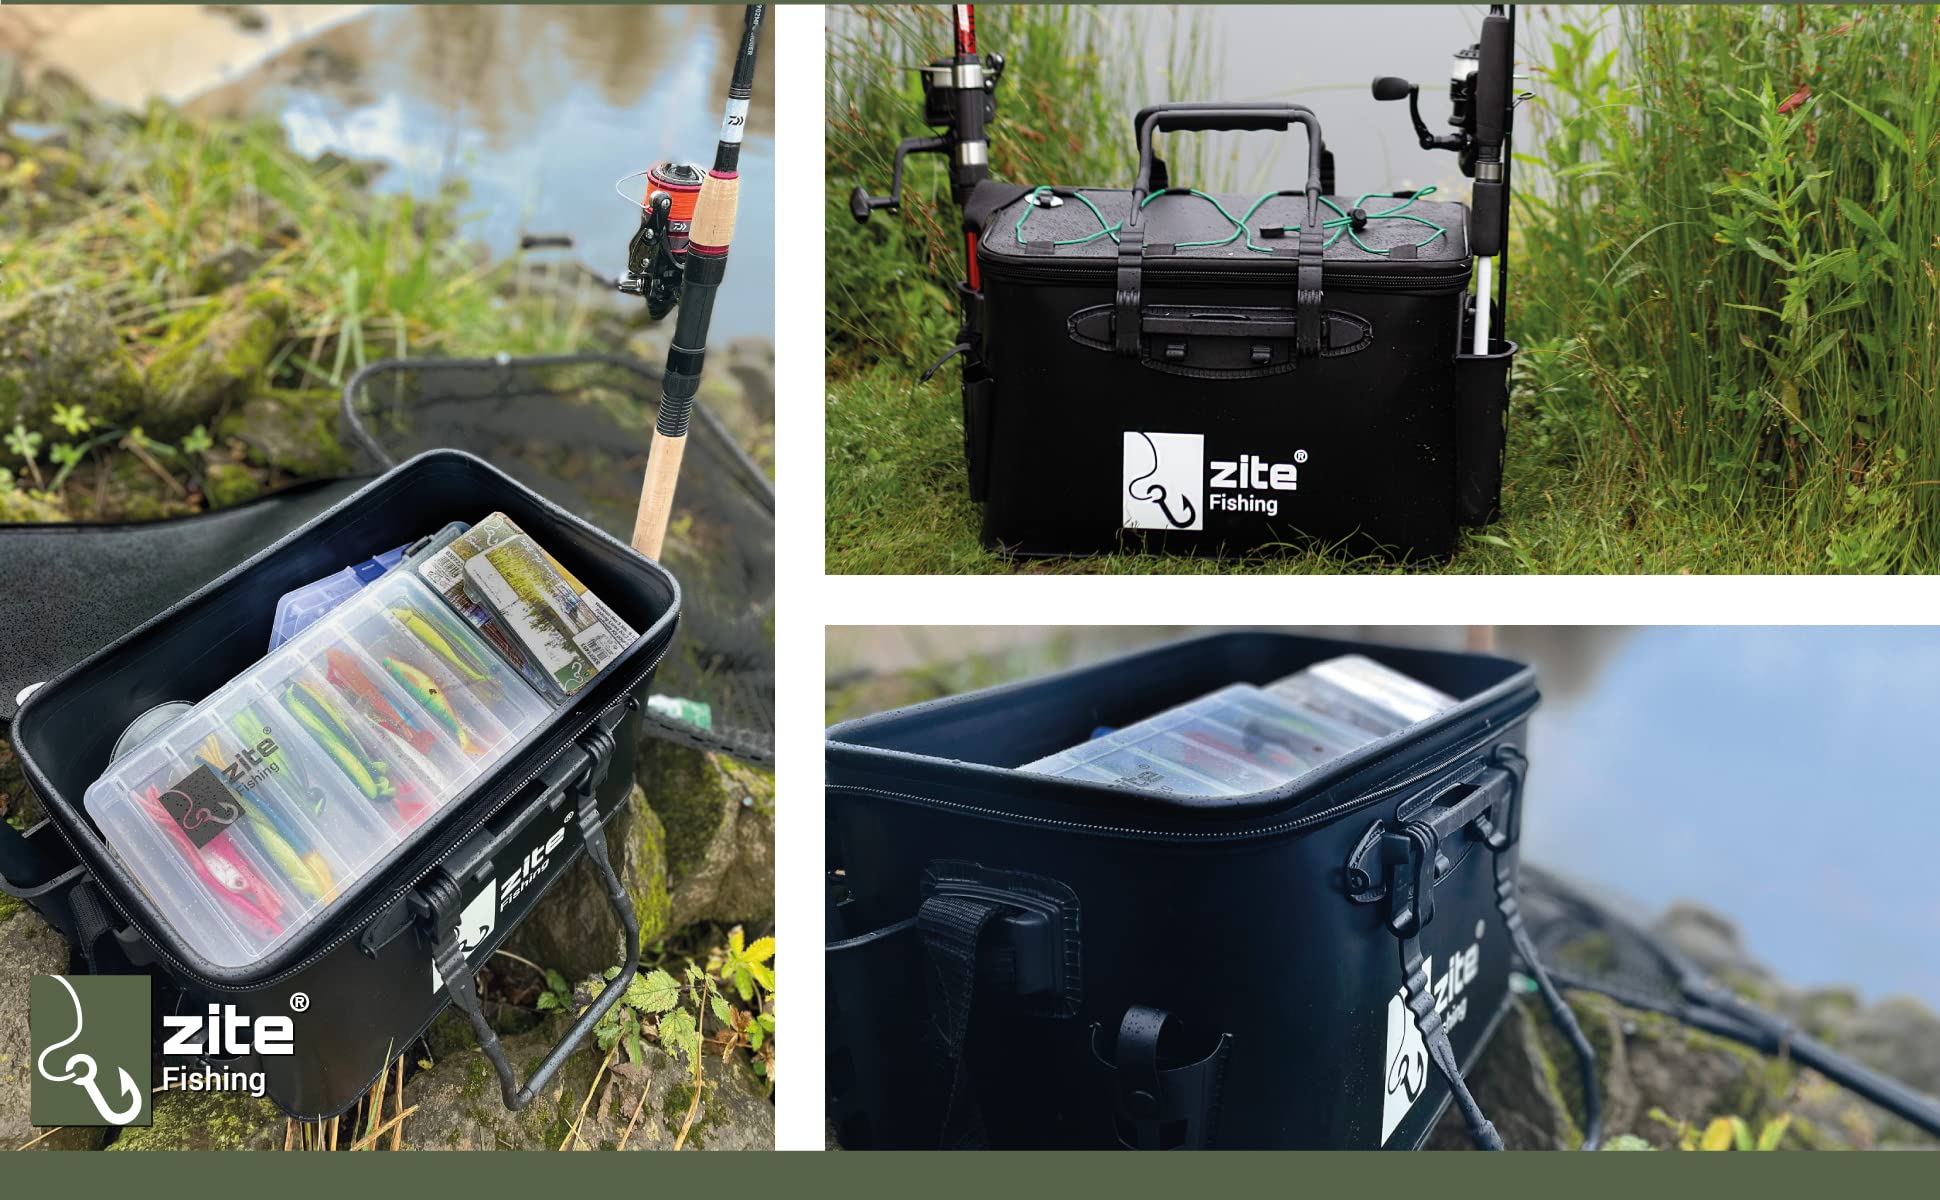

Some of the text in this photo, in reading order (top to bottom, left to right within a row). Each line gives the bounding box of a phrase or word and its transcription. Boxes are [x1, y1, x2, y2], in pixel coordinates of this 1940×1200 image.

[1209, 494, 1278, 516] Fishing
[236, 762, 280, 797] Fishing
[500, 858, 550, 912] Fishing
